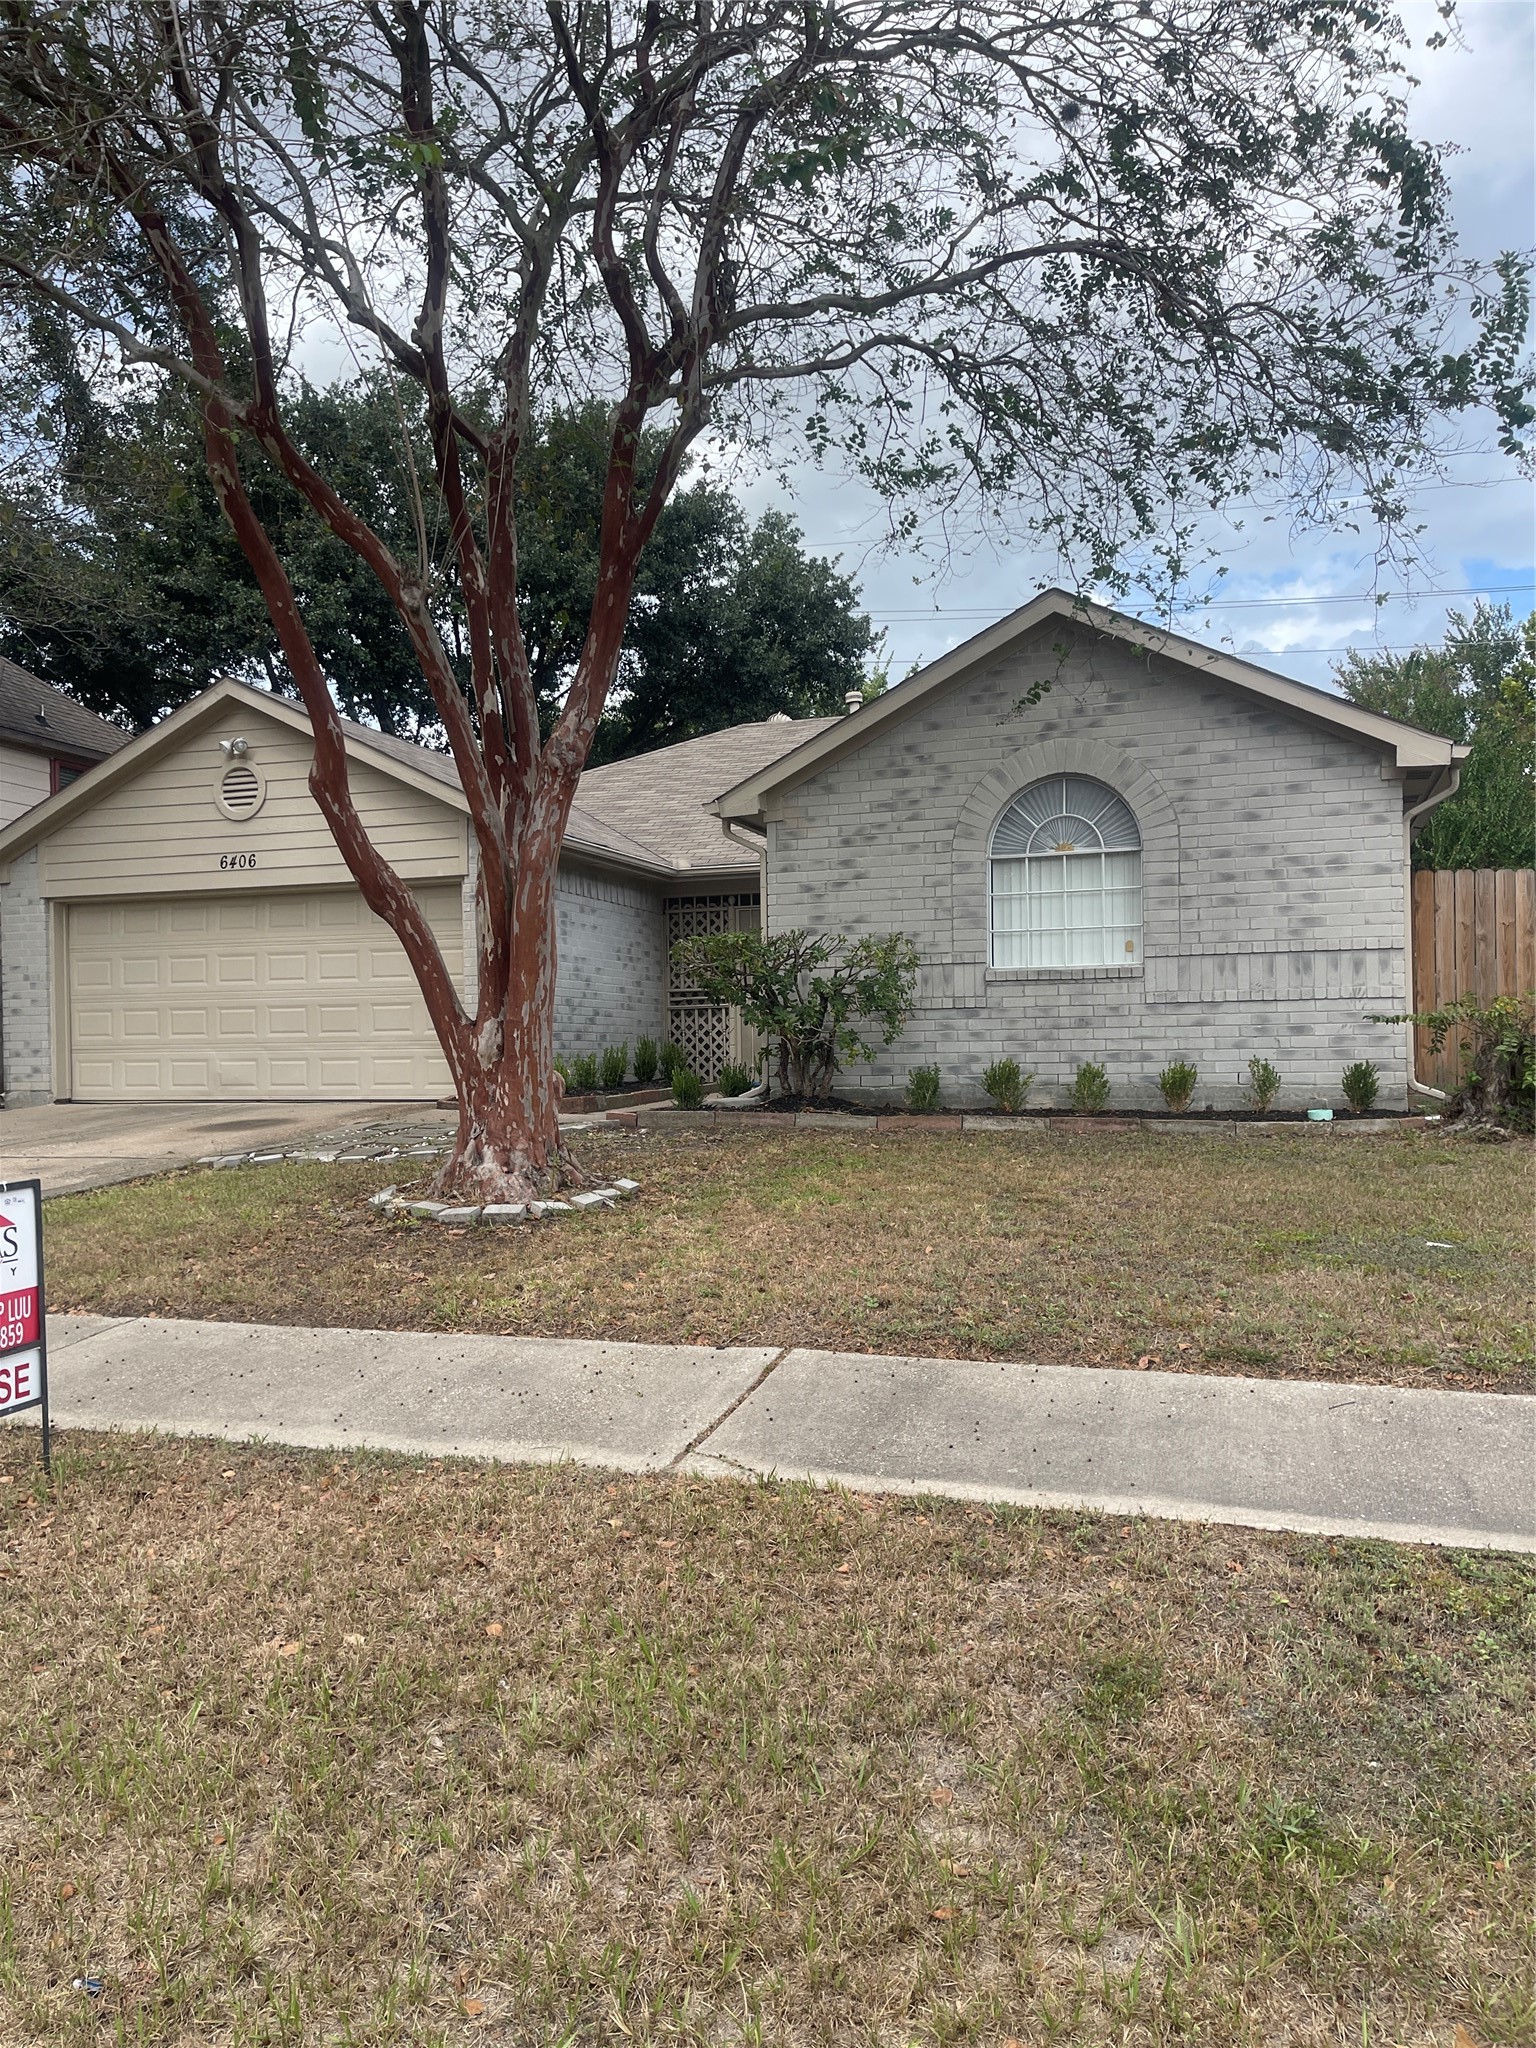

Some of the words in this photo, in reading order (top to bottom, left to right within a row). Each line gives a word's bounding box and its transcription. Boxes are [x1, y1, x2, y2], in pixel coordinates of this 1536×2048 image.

[220, 853, 257, 870] 6406
[0, 1226, 18, 1258] S
[10, 1267, 17, 1276] Y
[8, 1295, 31, 1322] LUU
[0, 1322, 24, 1349] 859
[0, 1363, 30, 1404] SE
